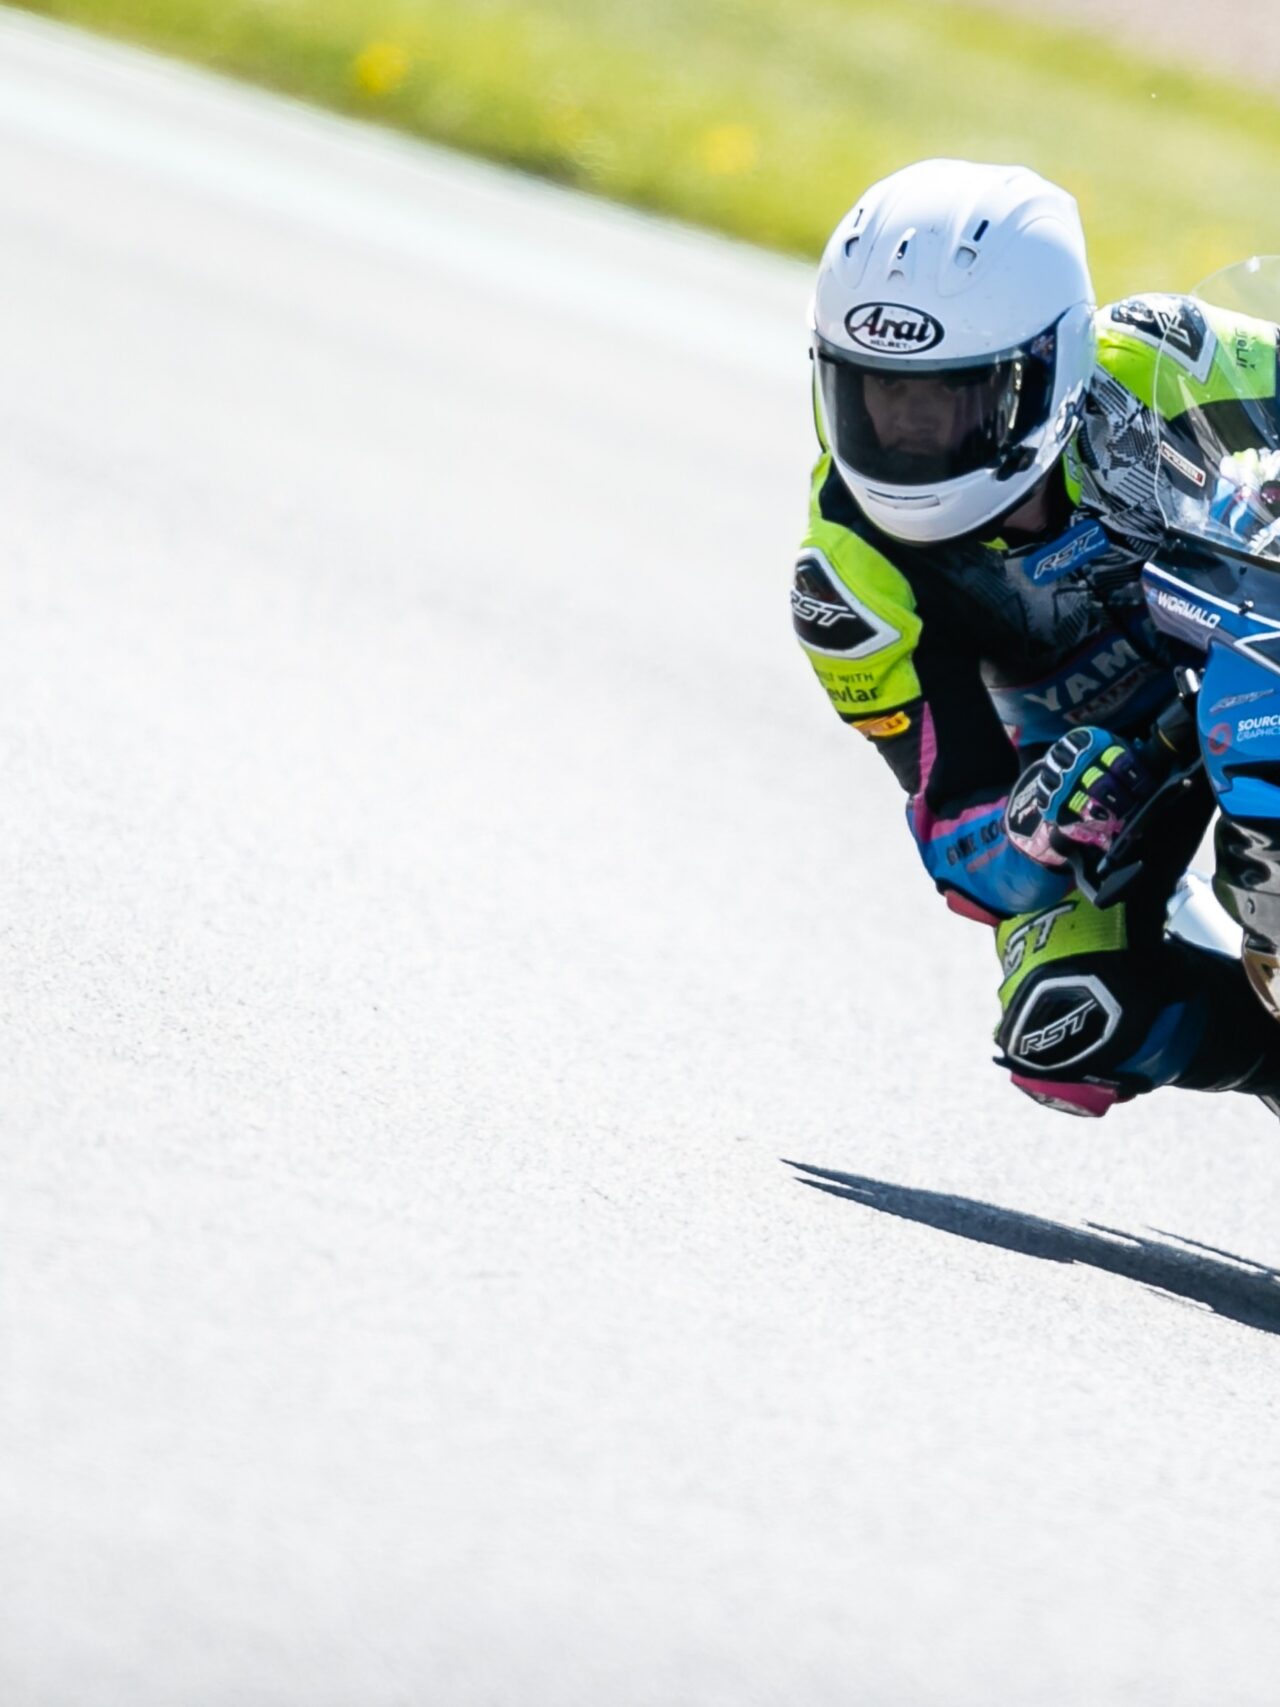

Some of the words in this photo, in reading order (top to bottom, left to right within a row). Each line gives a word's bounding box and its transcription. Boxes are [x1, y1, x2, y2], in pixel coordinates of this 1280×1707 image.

[848, 306, 931, 343] Arai
[1033, 526, 1105, 580] RST
[1019, 999, 1098, 1056] RST
